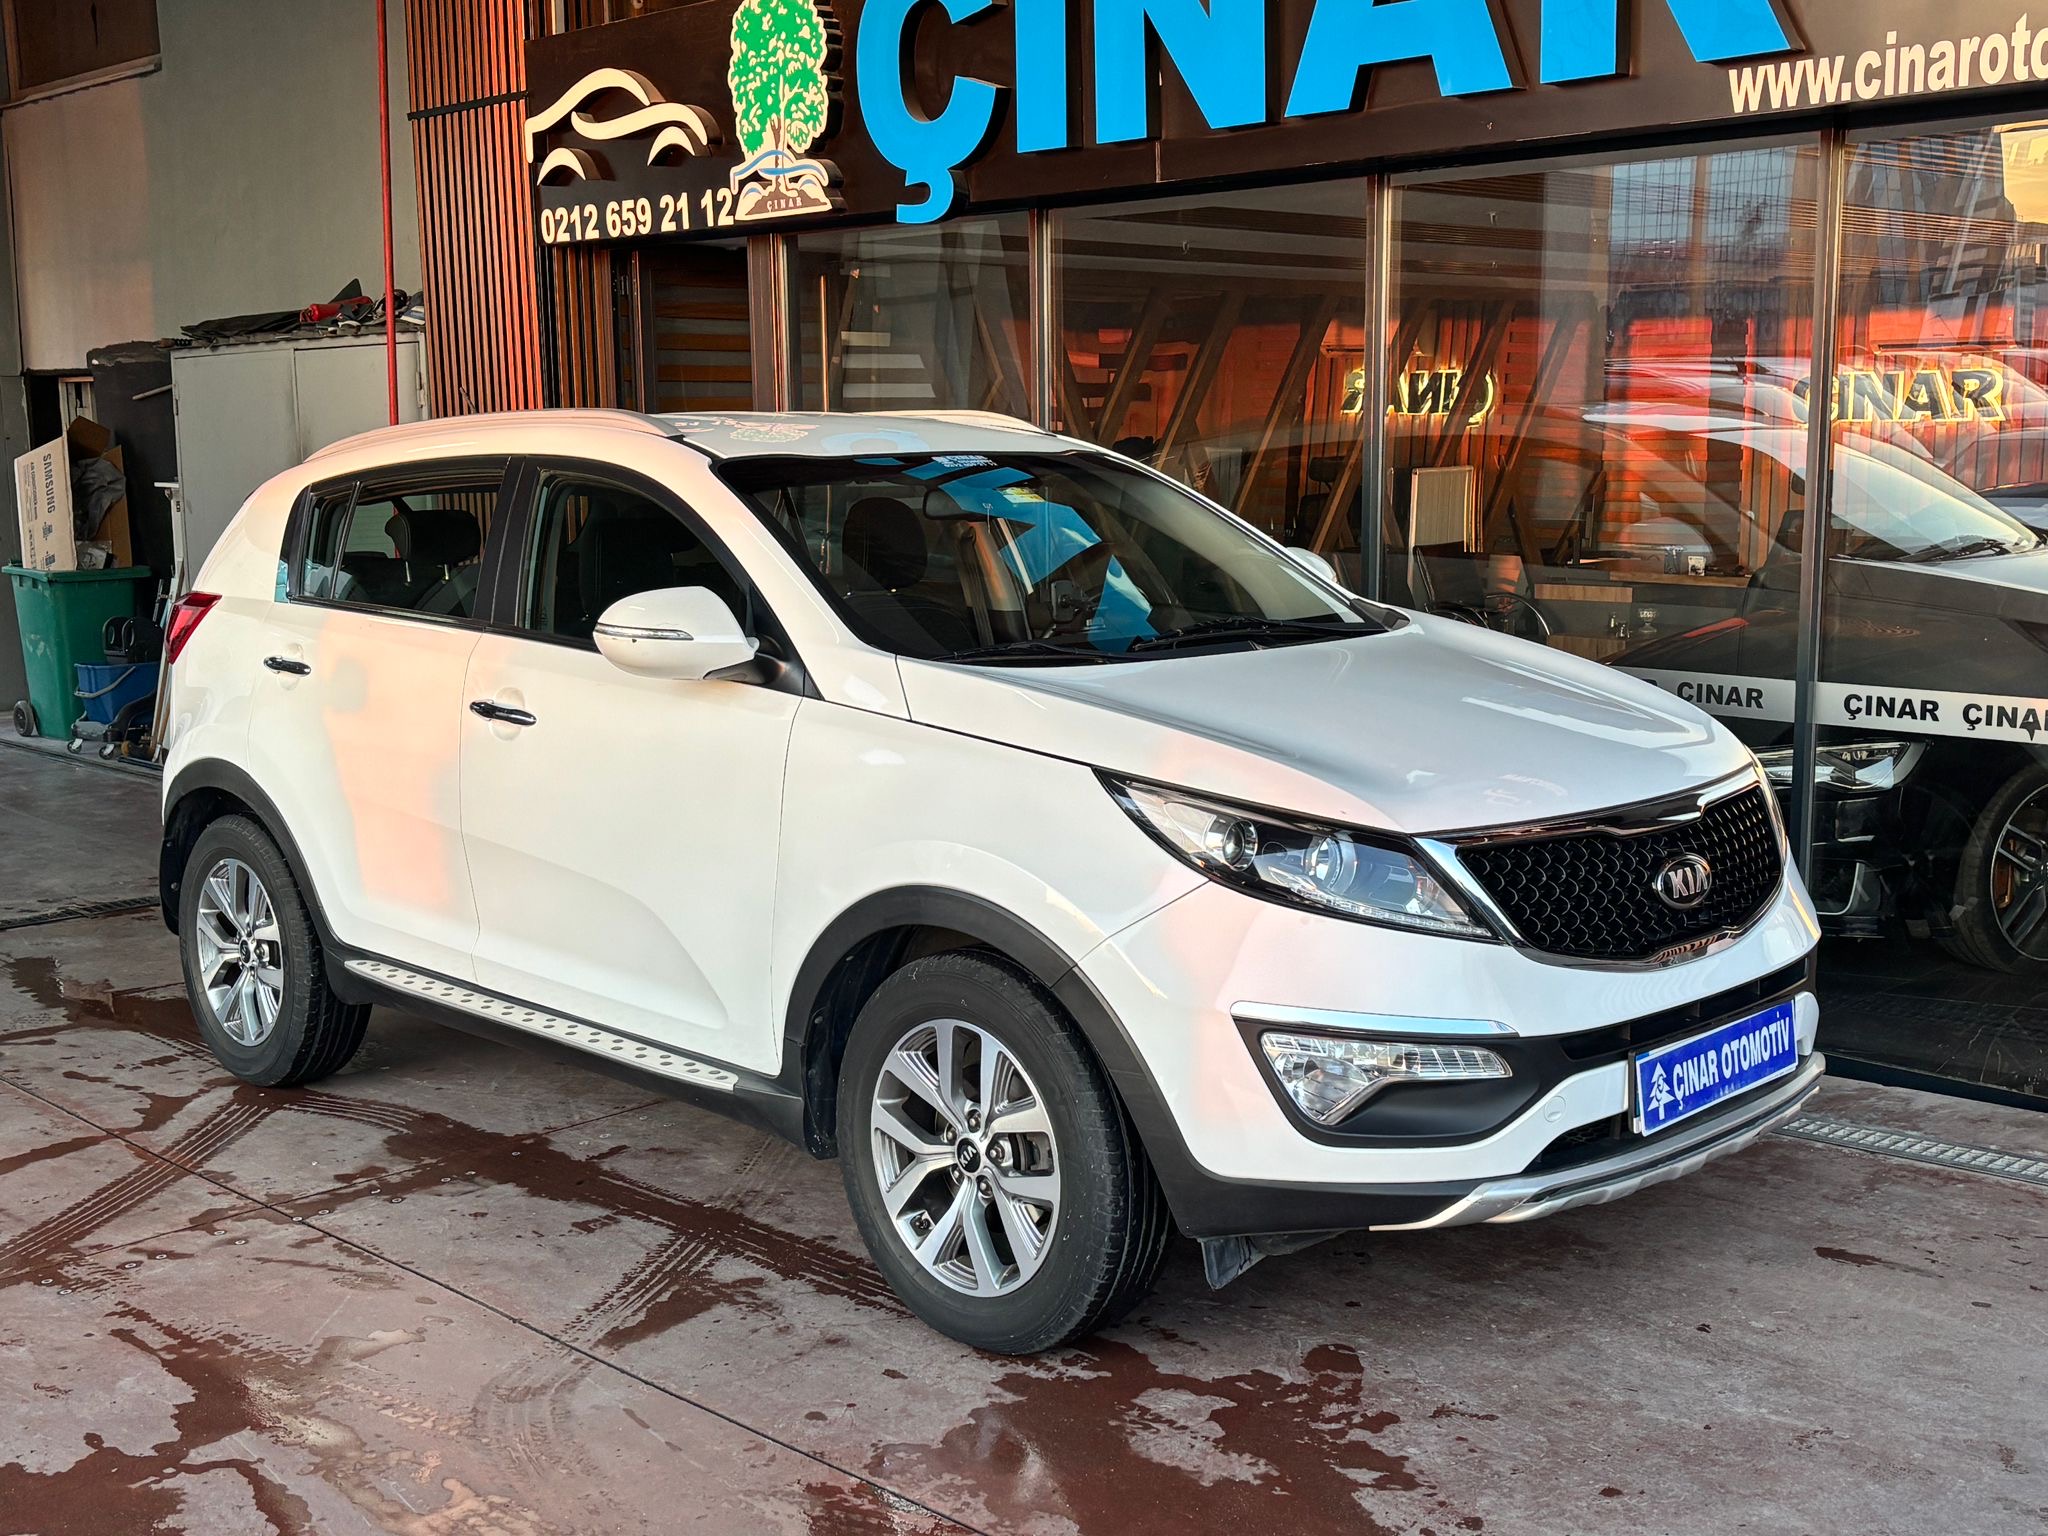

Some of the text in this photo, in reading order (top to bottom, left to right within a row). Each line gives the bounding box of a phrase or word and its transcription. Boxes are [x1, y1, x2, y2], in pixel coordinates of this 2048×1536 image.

[857, 0, 1797, 223] ÇIN
[540, 187, 735, 244] 0212 659 21 12
[766, 197, 802, 212] ÇINAR
[42, 453, 56, 514] SAMSUNG
[1843, 692, 2048, 732] ÇINAR ÇINA
[1667, 864, 1708, 899] KIA
[1672, 1010, 1790, 1111] ÇINAR OTOMOTİV
[958, 1145, 977, 1168] KIA
